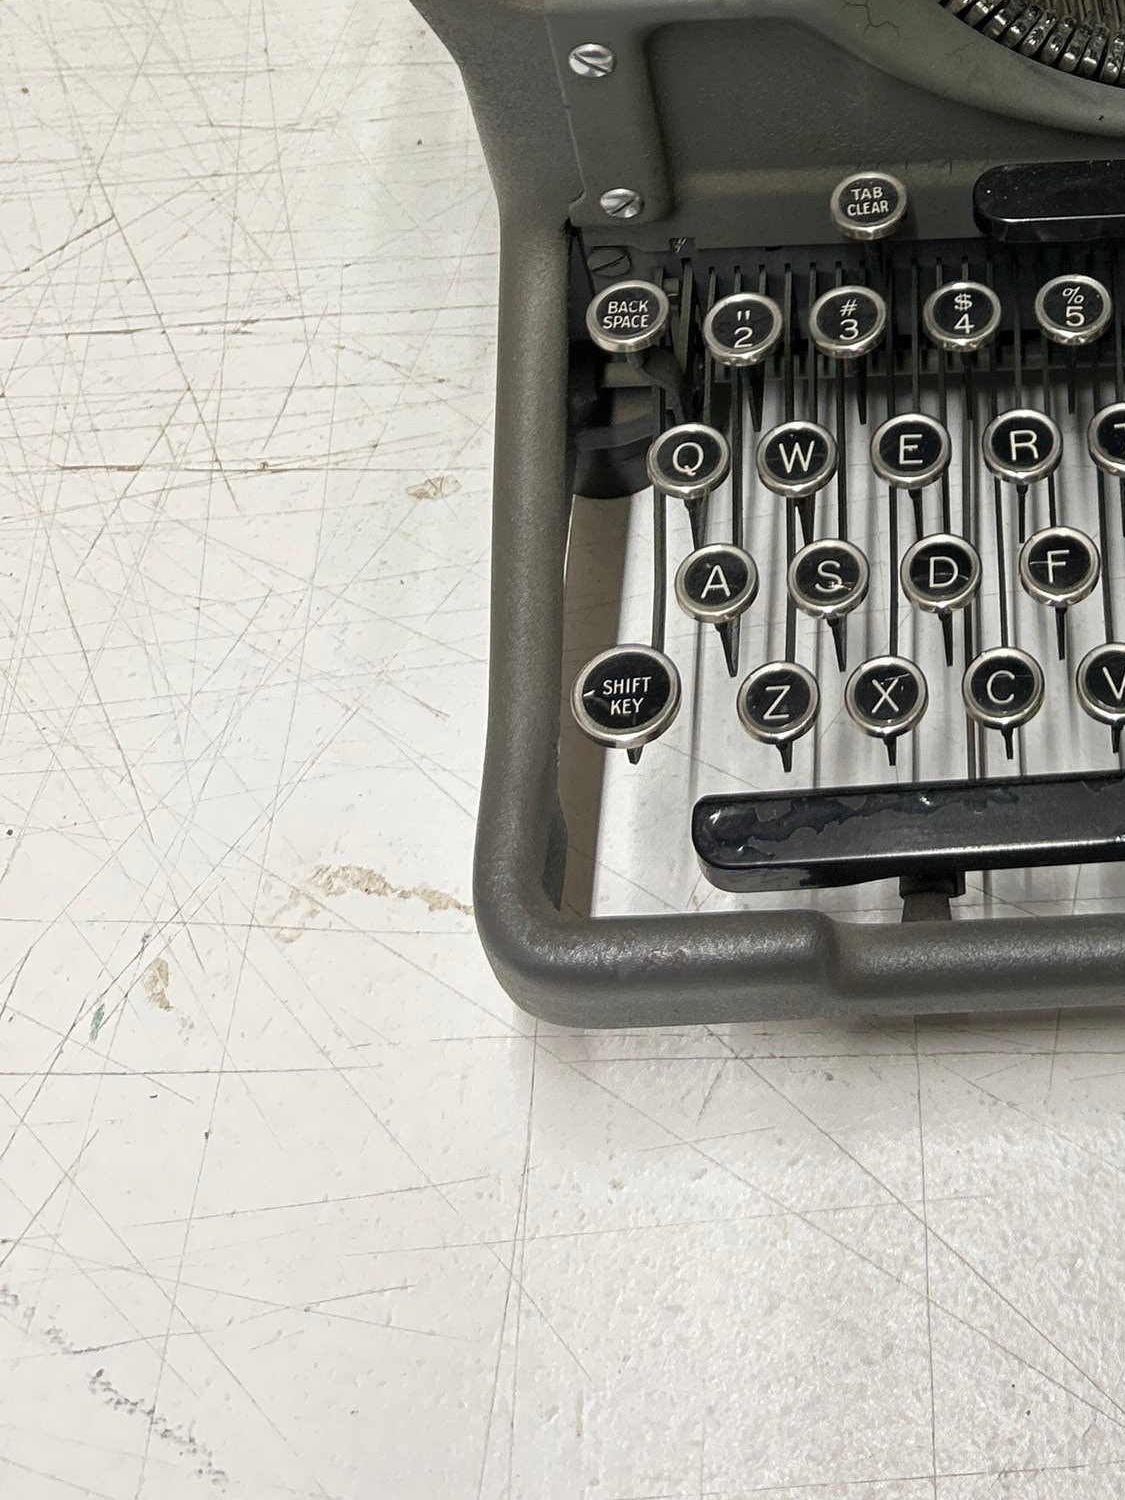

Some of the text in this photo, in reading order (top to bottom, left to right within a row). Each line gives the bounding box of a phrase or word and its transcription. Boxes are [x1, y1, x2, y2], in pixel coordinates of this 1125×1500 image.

[850, 186, 883, 200] TAB
[847, 201, 889, 217] CLEAR
[606, 299, 650, 314] BACK
[954, 293, 973, 311] $
[1062, 286, 1085, 305] %
[839, 299, 858, 317] #
[1065, 305, 1085, 327] 5
[602, 314, 649, 330] SPACE
[842, 318, 859, 341] 3
[953, 313, 975, 334] 4
[733, 326, 753, 348] 2
[901, 433, 923, 465] E
[1009, 429, 1039, 461] R
[672, 441, 704, 477] Q
[778, 440, 815, 474] W
[815, 560, 843, 593] S
[929, 556, 959, 588] D
[1046, 549, 1070, 584] F
[700, 563, 731, 599] A
[602, 676, 652, 696] SHIFT
[871, 679, 899, 714] X
[986, 670, 1016, 705] C
[610, 697, 644, 716] KEY
[763, 684, 791, 720] Z
